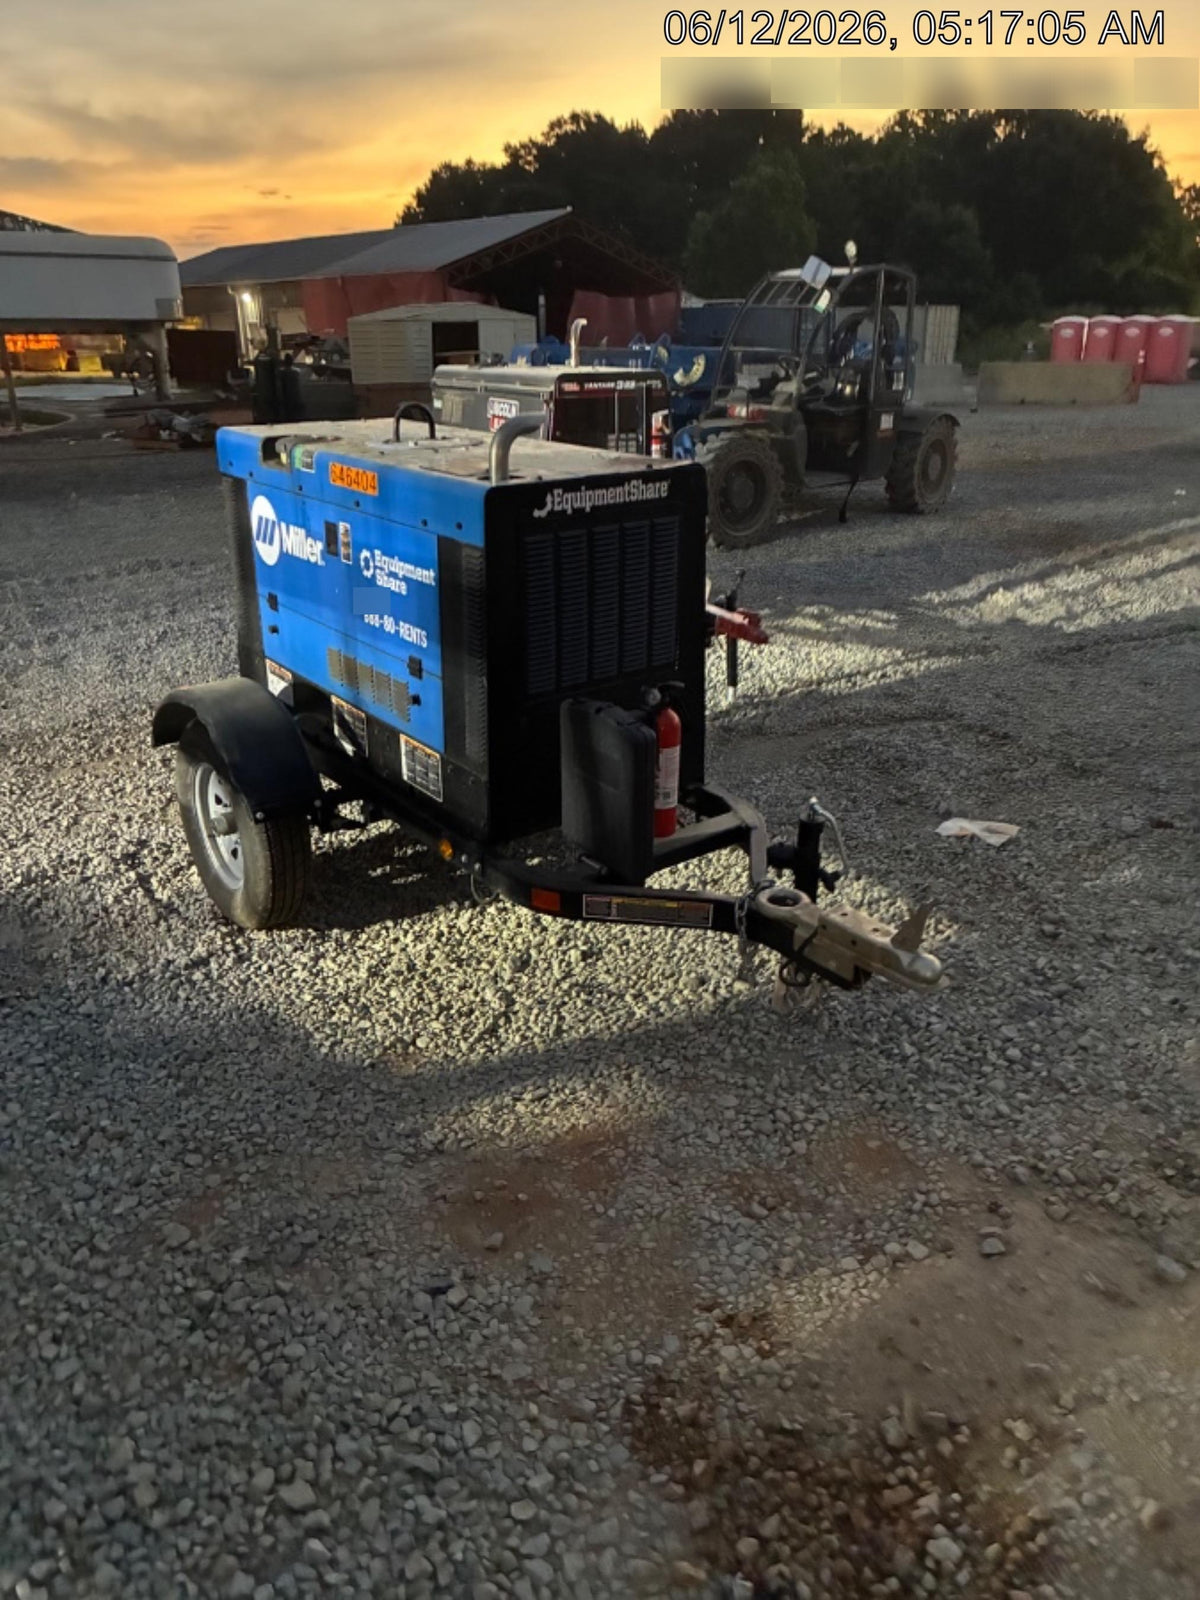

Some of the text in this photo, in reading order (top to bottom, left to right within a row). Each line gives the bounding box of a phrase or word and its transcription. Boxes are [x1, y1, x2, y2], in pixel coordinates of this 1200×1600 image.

[553, 479, 669, 515] EquipmentShare
[280, 521, 325, 566] Miller
[374, 549, 436, 586] Equipment
[375, 569, 407, 596] Share
